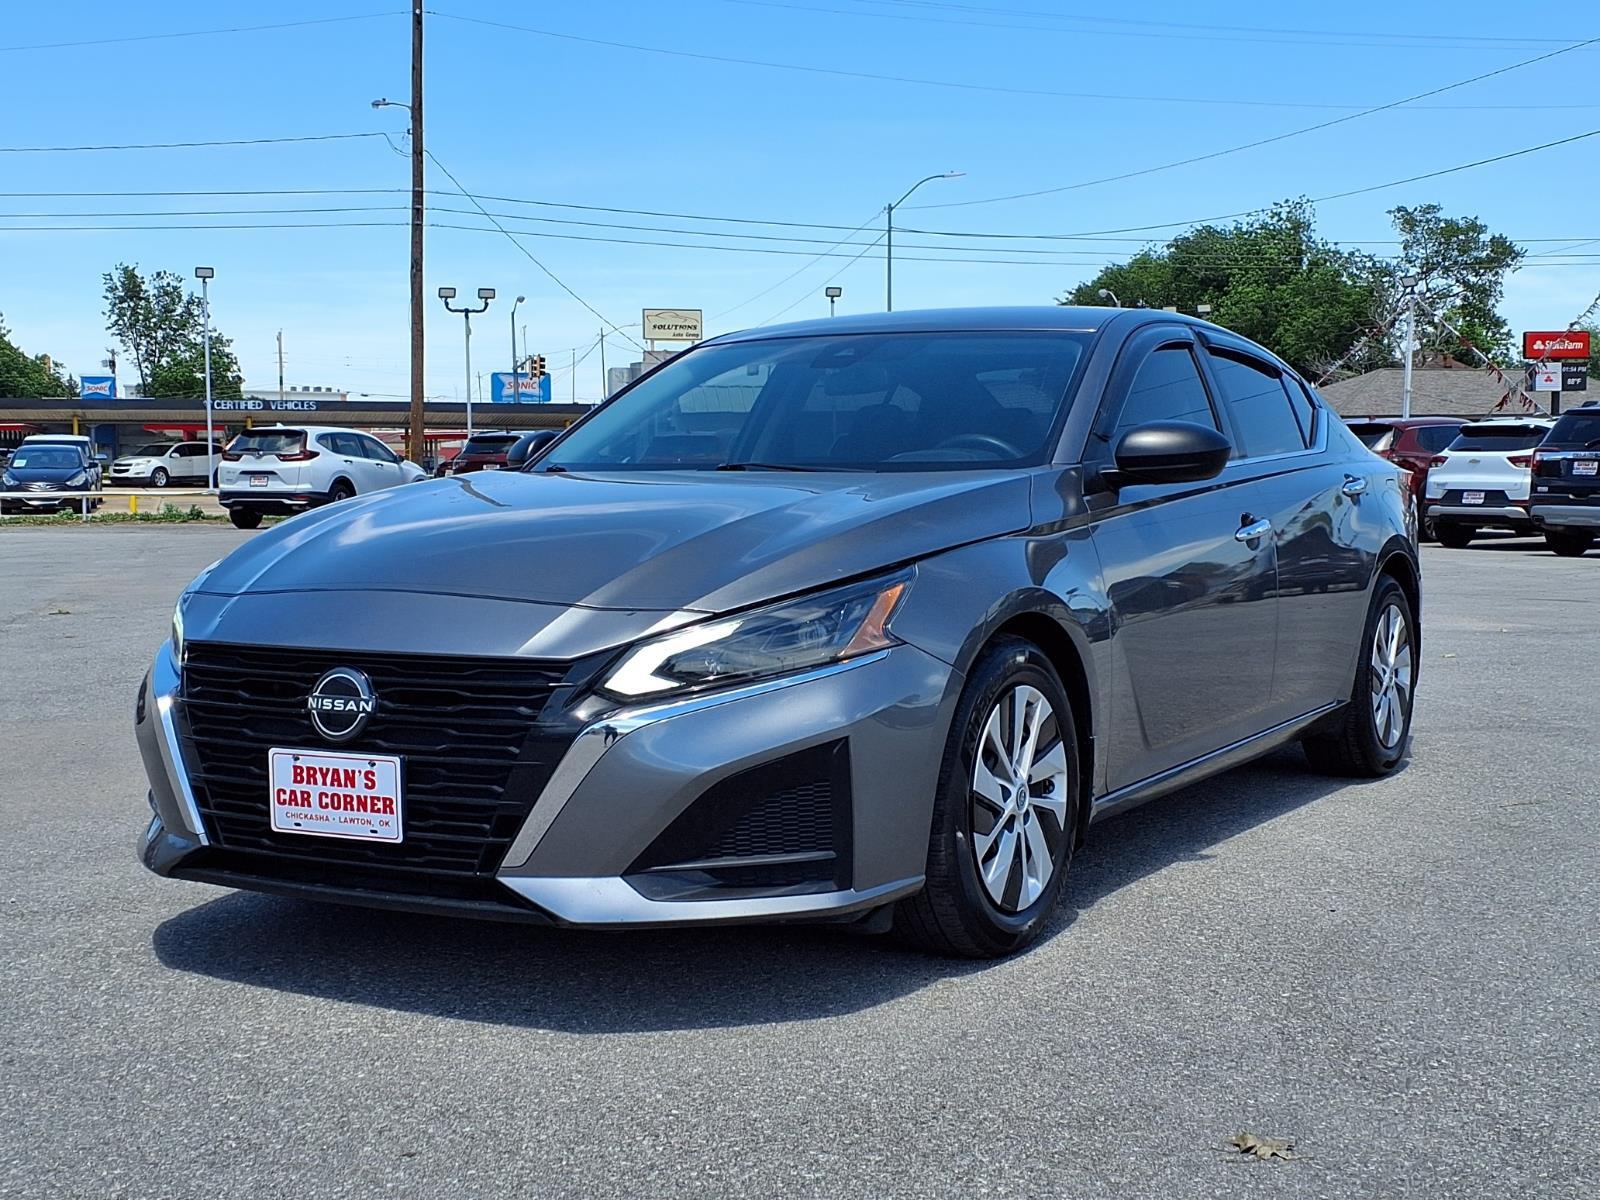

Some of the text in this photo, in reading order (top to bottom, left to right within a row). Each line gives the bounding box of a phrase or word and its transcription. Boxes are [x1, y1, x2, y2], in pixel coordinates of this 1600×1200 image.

[506, 381, 537, 390] SNIC
[213, 400, 317, 410] CERTIFIED VEHICLES
[307, 696, 373, 712] NISSAN
[292, 764, 377, 790] BRYAN'S
[276, 788, 395, 815] CAR CORNER
[285, 811, 391, 827] CHICKASHA LAWTON, OK
